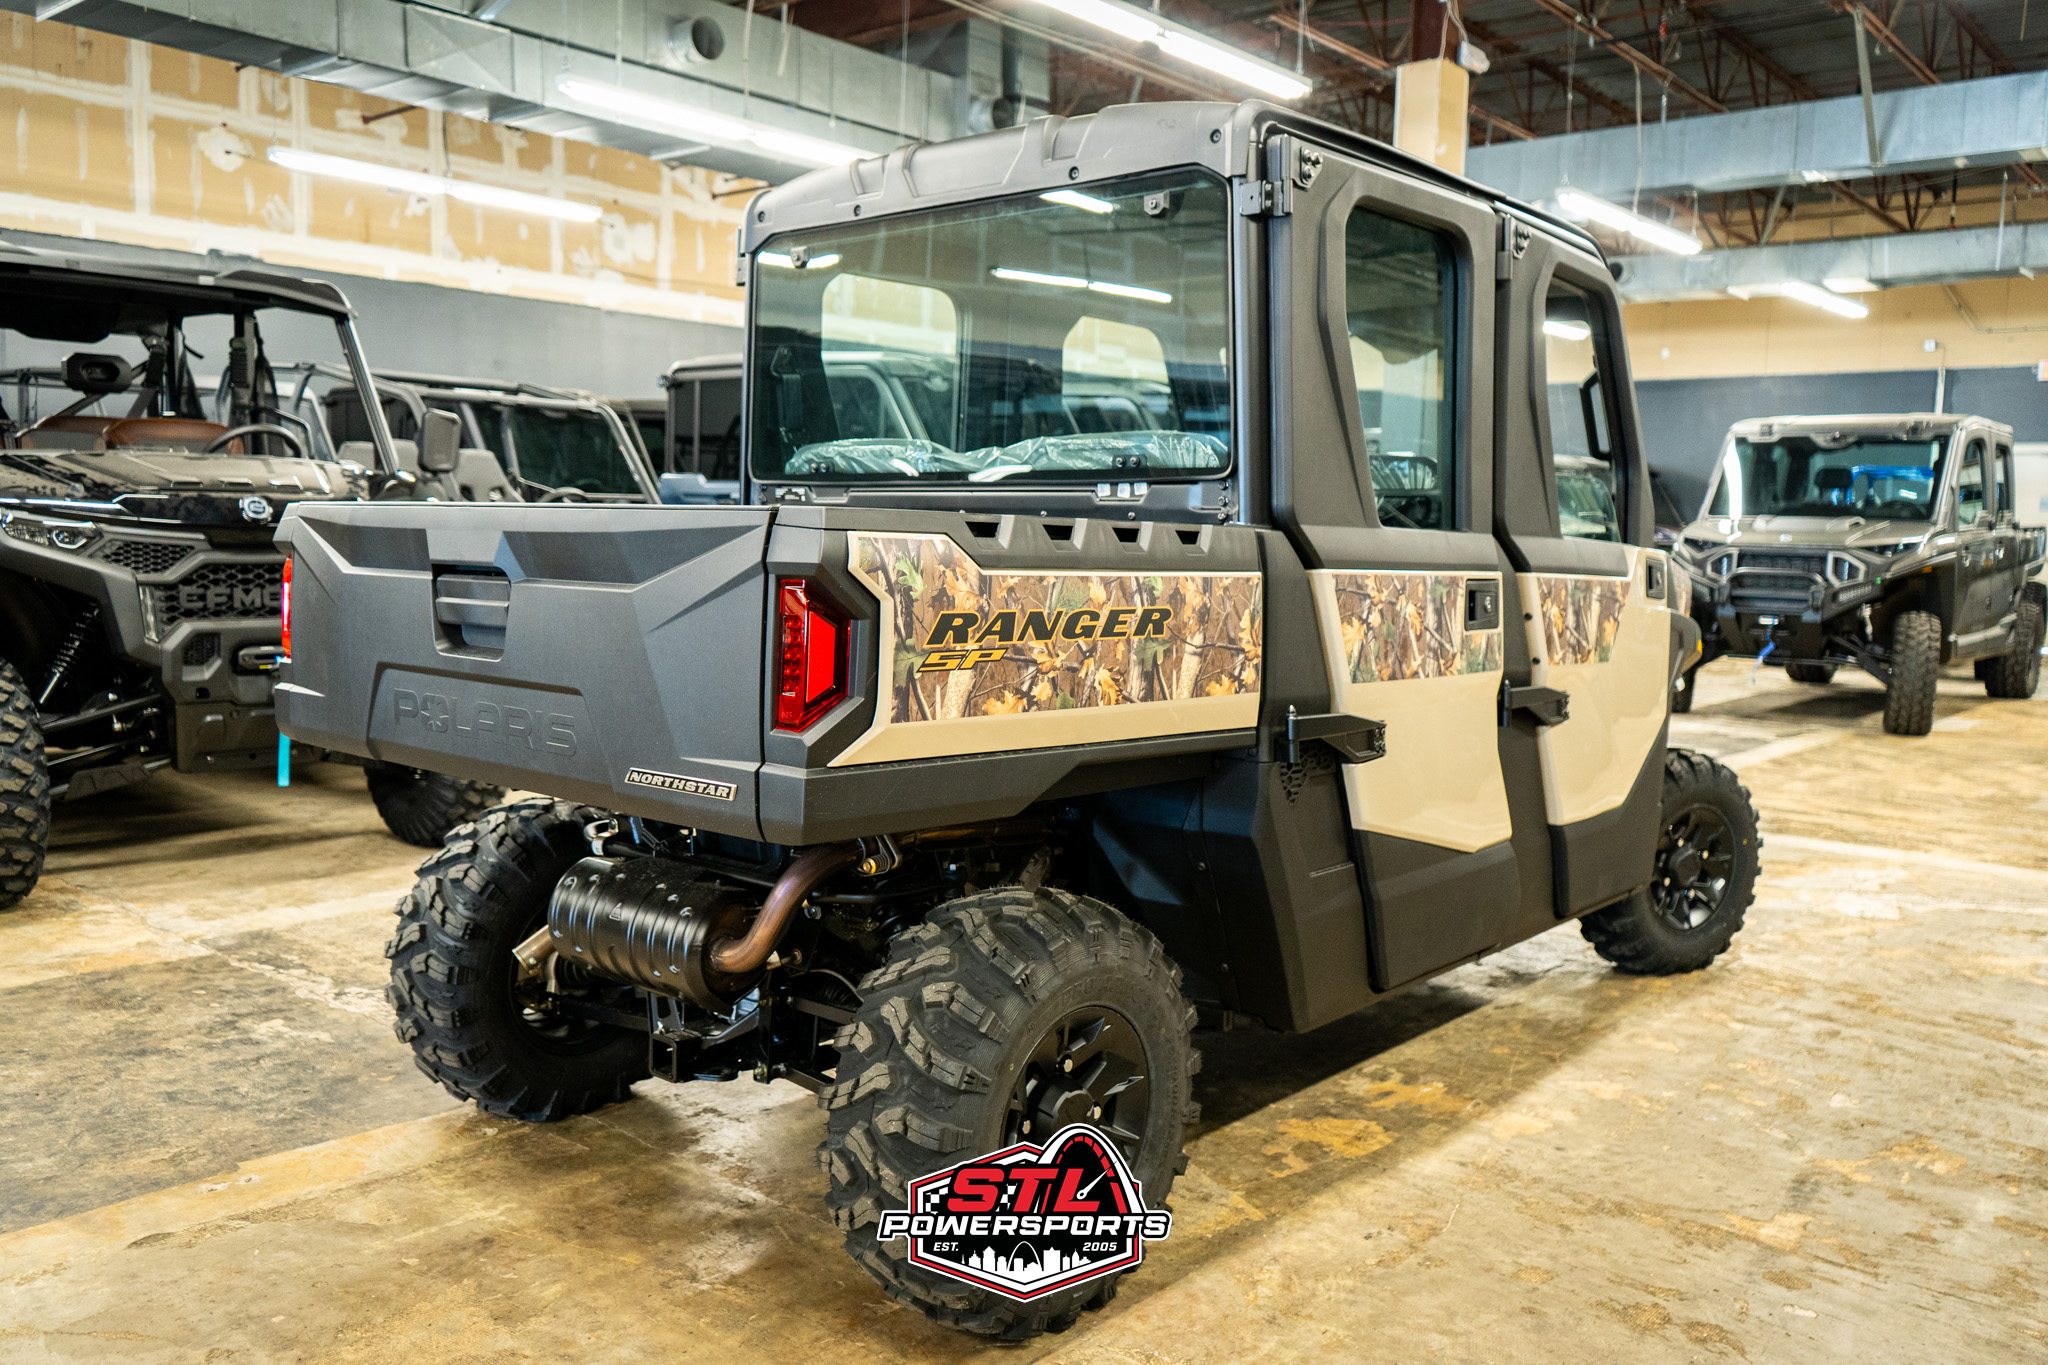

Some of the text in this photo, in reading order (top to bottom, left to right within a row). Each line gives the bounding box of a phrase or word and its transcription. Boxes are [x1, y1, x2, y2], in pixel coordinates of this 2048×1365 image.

[923, 606, 1173, 648] RANGER
[916, 647, 1008, 673] SP
[629, 771, 730, 798] NORTHSTAR
